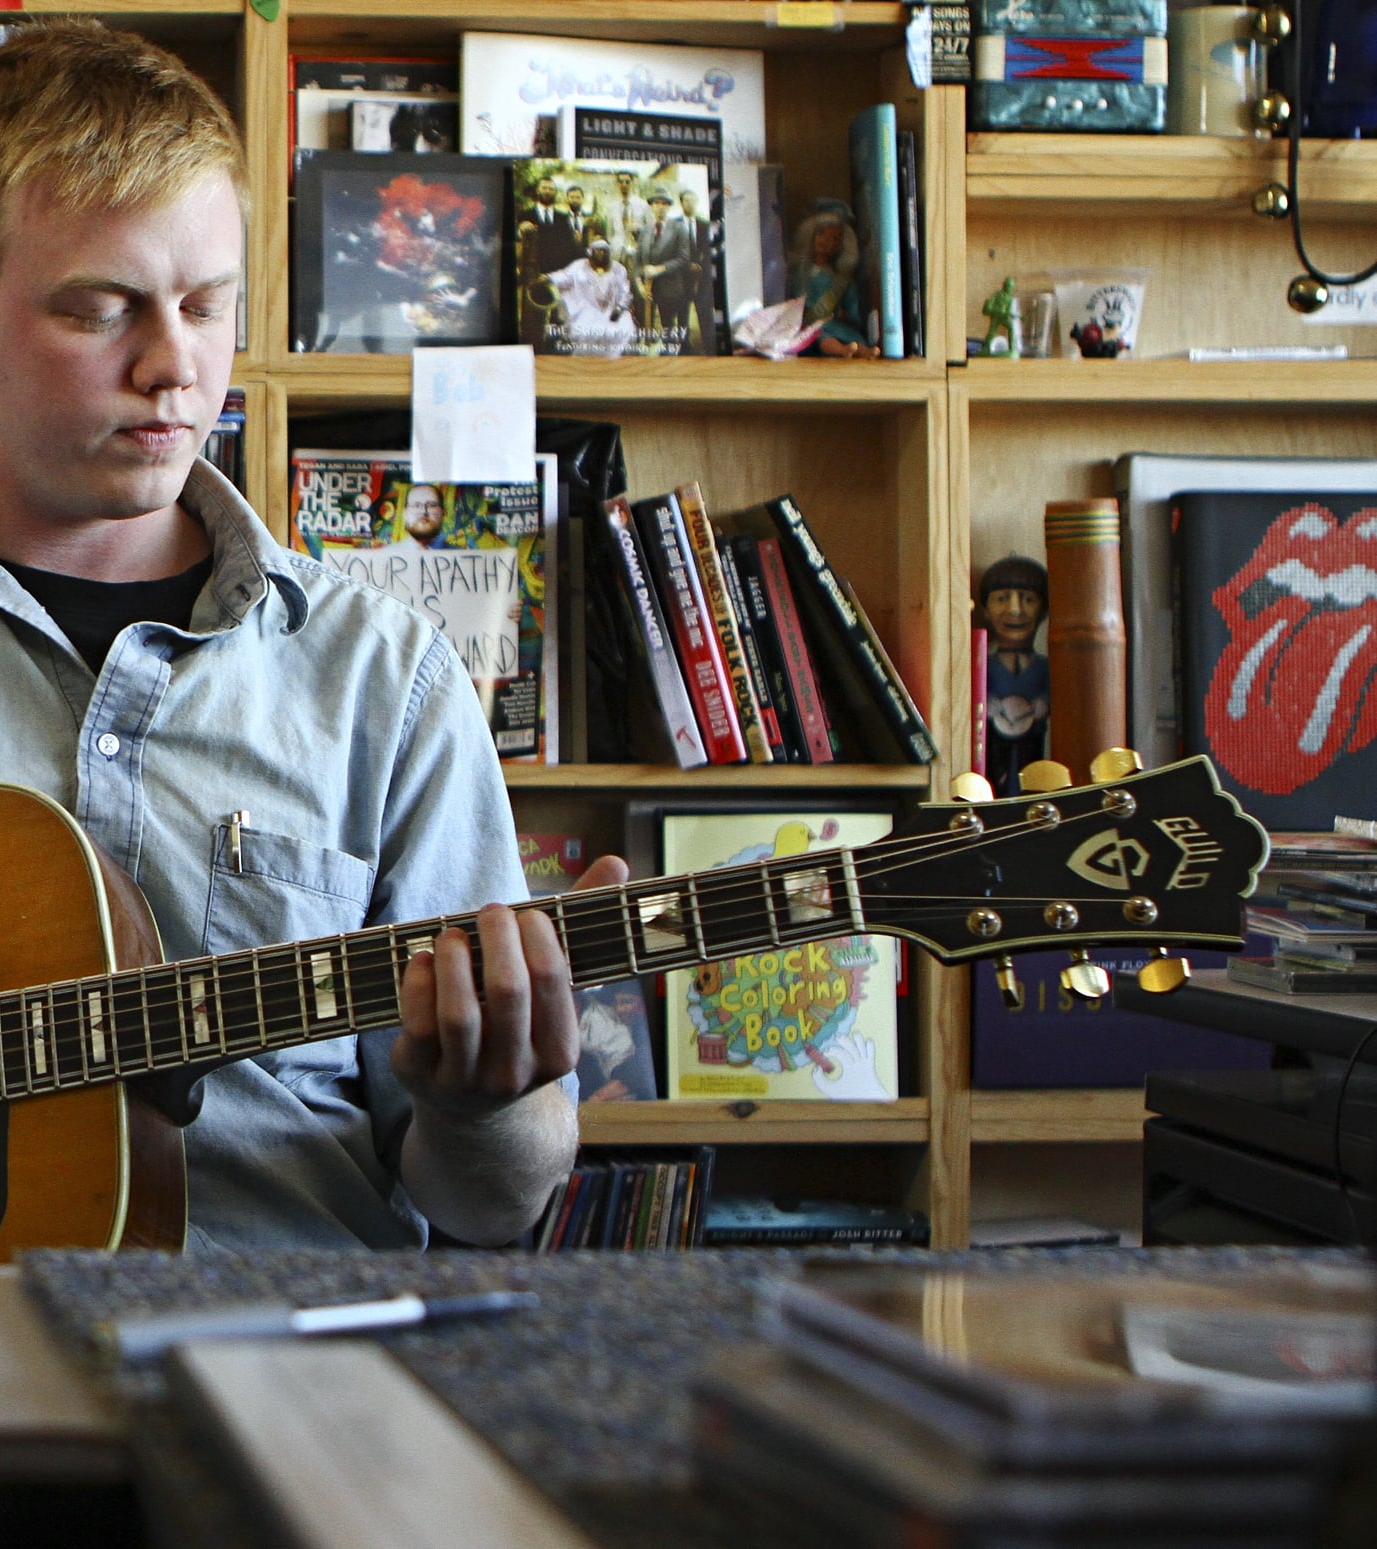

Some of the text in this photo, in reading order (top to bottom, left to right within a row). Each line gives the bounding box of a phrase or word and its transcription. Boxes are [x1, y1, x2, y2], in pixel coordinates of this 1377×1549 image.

[933, 6, 970, 18] SONGS
[583, 116, 717, 143] LIGHT & SHADE
[548, 324, 568, 336] THE
[299, 472, 372, 492] UNDER
[484, 486, 539, 499] Protest
[302, 492, 342, 512] THE
[298, 511, 372, 532] RADAR
[495, 512, 539, 527] DAN
[655, 506, 675, 532] shut
[495, 526, 539, 535] DEACON
[666, 546, 686, 567] and
[327, 553, 518, 595] YOUR APATHY
[669, 569, 689, 591] give
[618, 529, 664, 651] COSMIC DANCER
[678, 590, 695, 608] me
[748, 576, 767, 619] JAGGER
[410, 596, 447, 630] S
[682, 606, 702, 627] the
[689, 509, 709, 550] FOUR
[699, 550, 724, 603] DECADES
[718, 616, 742, 671] FOLK
[733, 673, 759, 729] ROCK
[695, 660, 730, 737] DEE SNIDER
[1152, 816, 1224, 891] GUILD
[719, 975, 848, 1012] Coloring
[745, 1008, 815, 1053] Book
[832, 1229, 862, 1239] JOSH
[864, 1229, 903, 1239] RITTER
